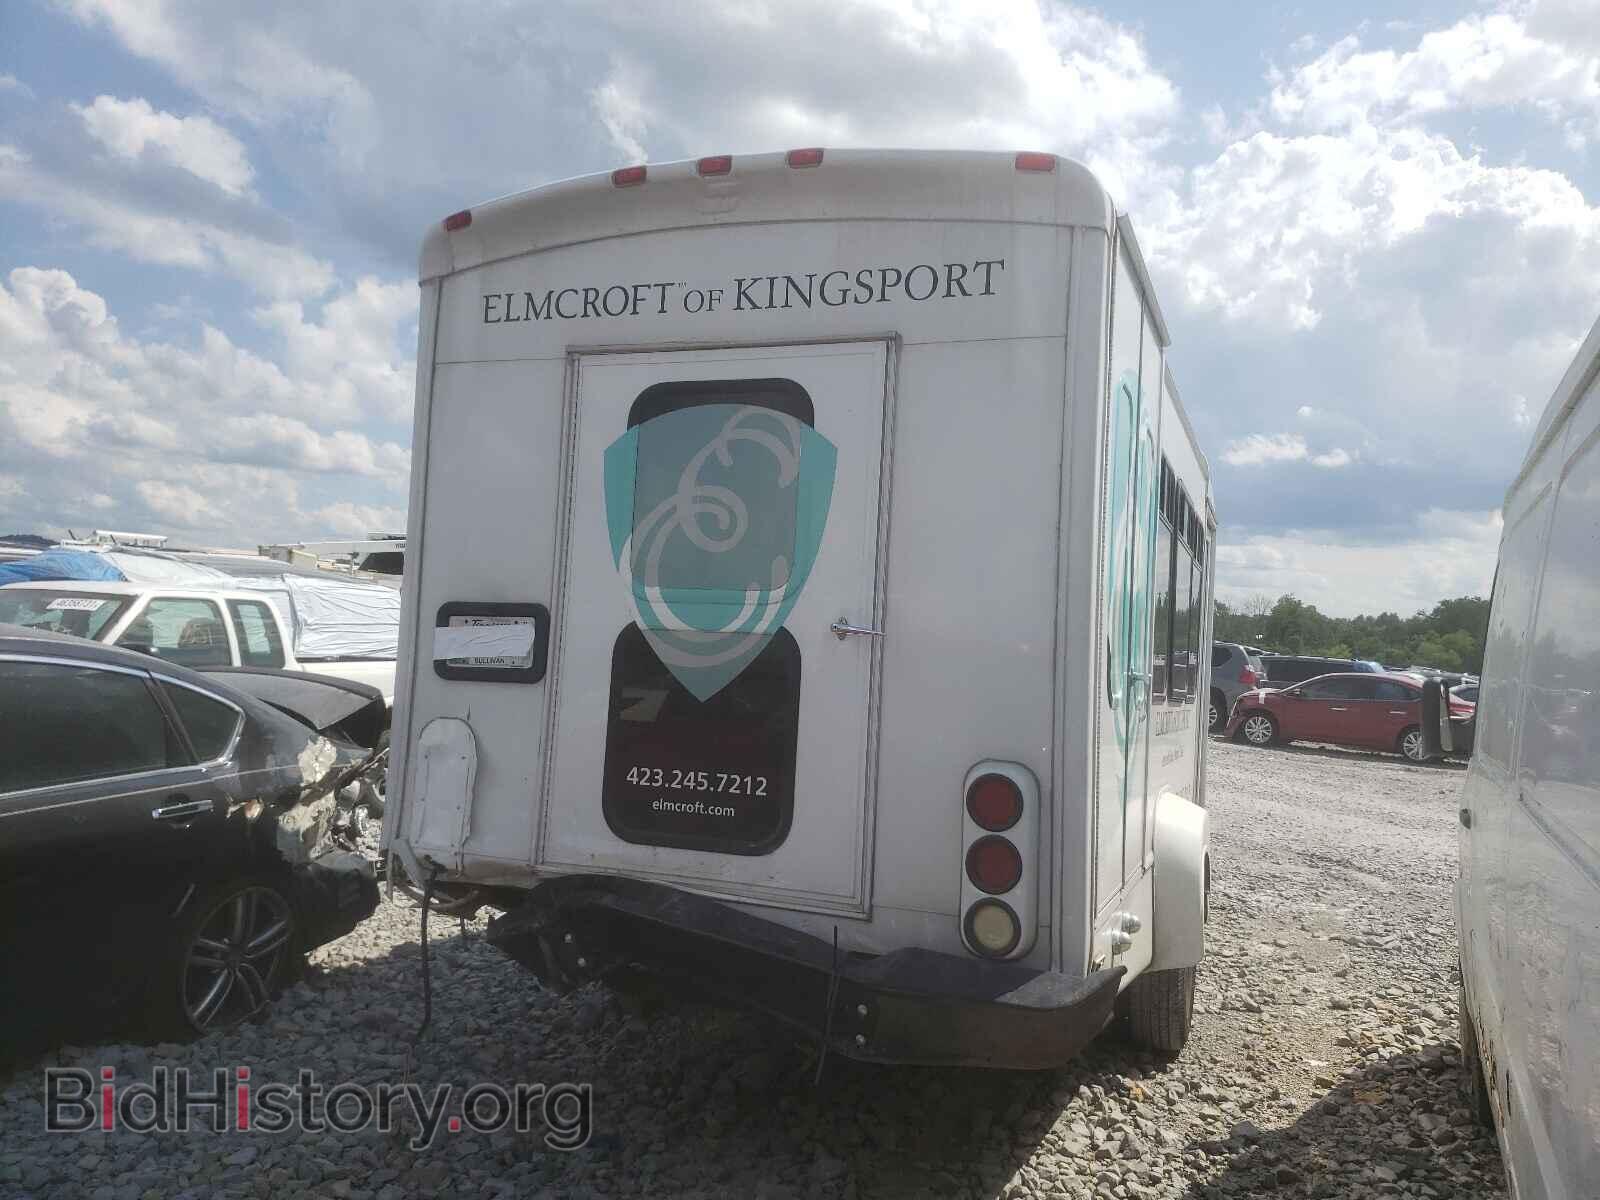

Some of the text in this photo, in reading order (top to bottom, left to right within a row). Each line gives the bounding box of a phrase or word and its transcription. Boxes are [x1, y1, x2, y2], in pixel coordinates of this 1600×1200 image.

[483, 282, 675, 324] ELMCROFT
[683, 289, 724, 313] OF
[732, 258, 1005, 311] KINGSPORT
[626, 766, 767, 796] 423.245.7212
[652, 798, 735, 817] elmcroft.com
